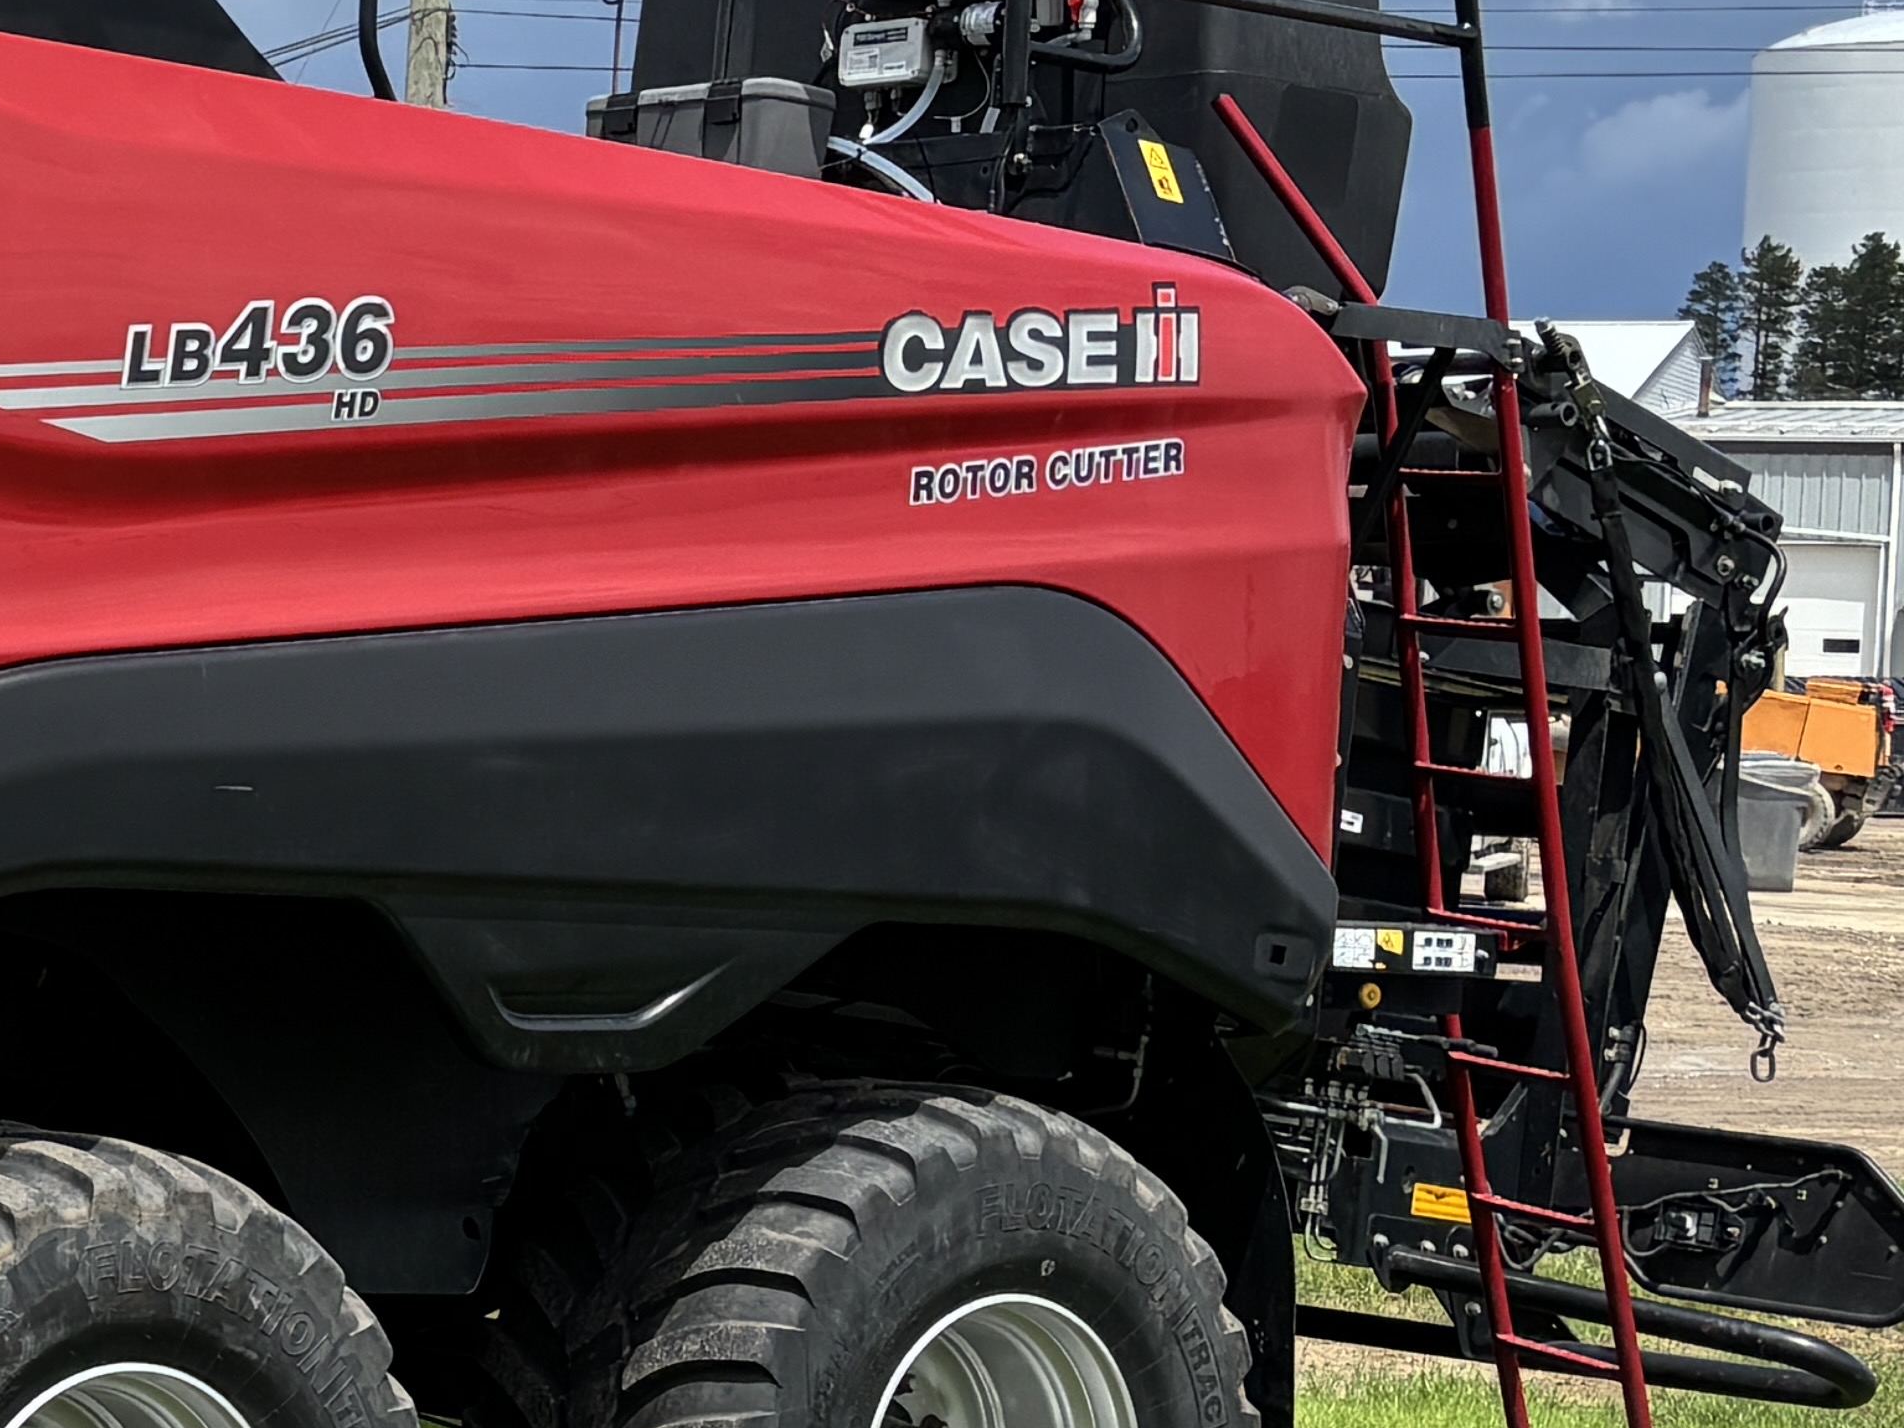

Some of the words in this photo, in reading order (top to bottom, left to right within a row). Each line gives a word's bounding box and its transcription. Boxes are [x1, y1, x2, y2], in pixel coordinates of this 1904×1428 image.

[121, 295, 395, 389] LB436
[883, 311, 1118, 392] CASE
[331, 388, 382, 421] HD
[909, 455, 1036, 506] ROTOR
[1045, 438, 1184, 490] CUTTER
[79, 1240, 357, 1402] FLOTATION
[976, 1181, 1194, 1324] FLOTATION
[1181, 1317, 1224, 1424] TRAC
